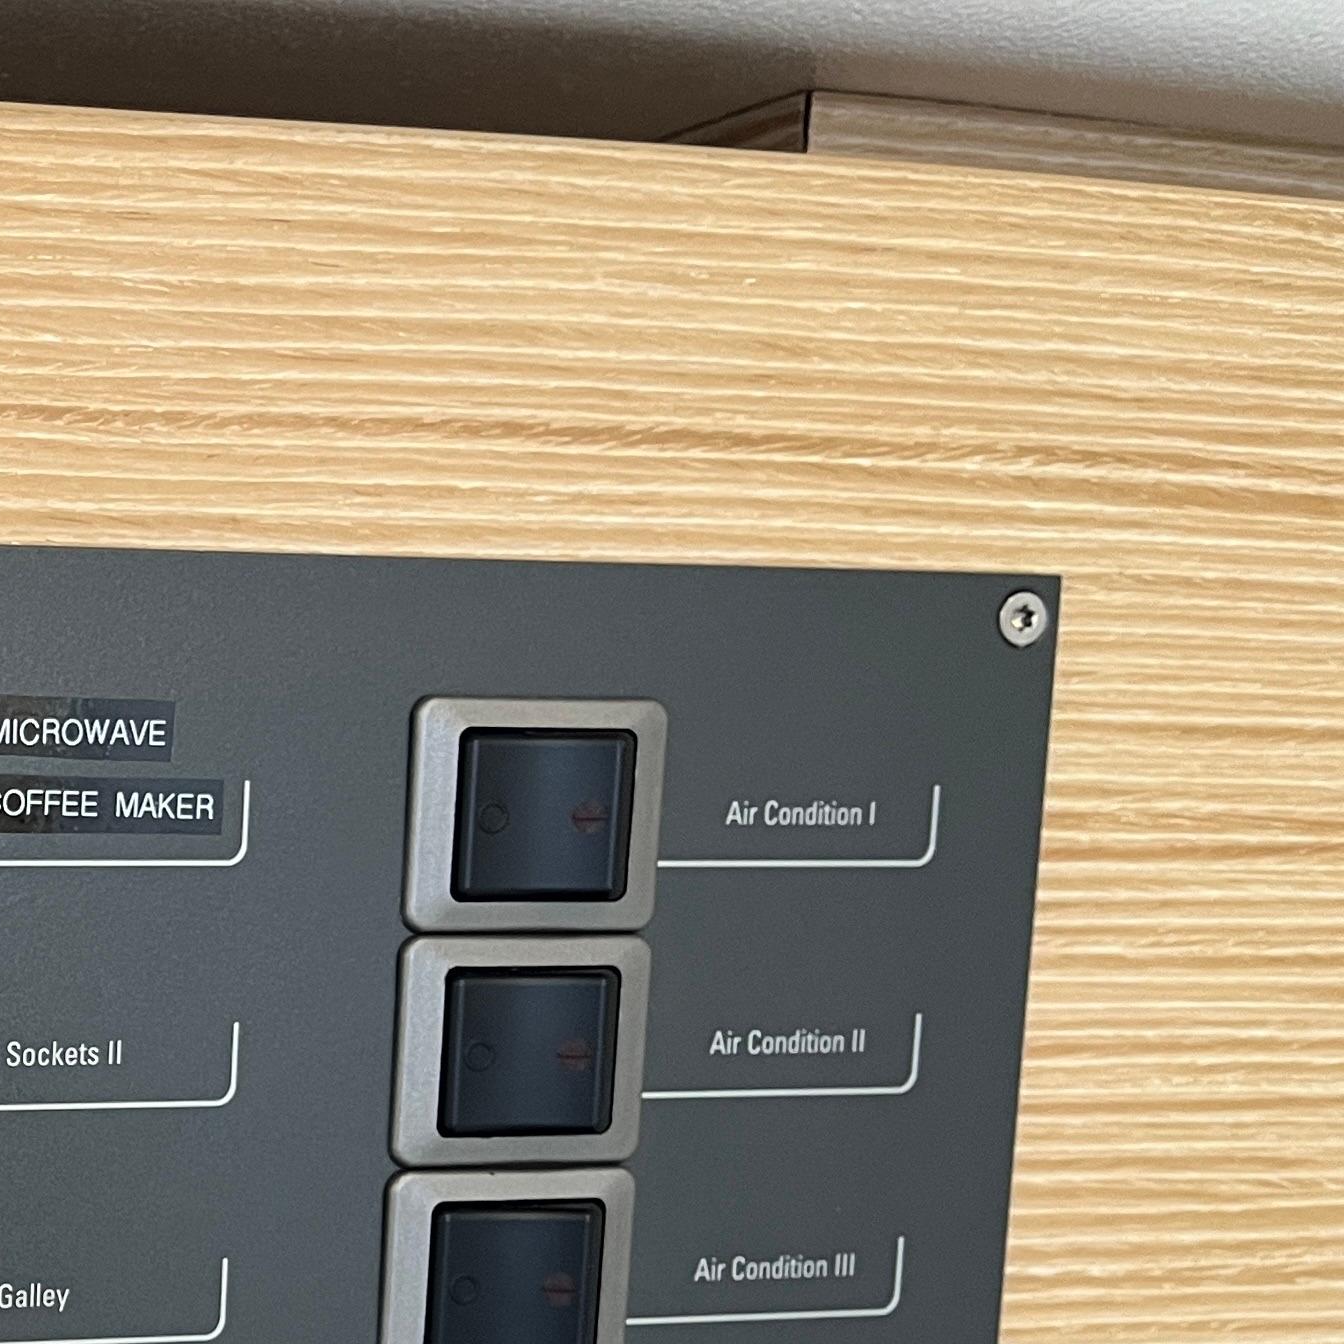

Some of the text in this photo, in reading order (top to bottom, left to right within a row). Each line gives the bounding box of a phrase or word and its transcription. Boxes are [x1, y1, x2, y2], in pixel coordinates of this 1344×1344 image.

[115, 791, 214, 820] MAKER
[725, 799, 876, 826] Air Condition I
[6, 1039, 122, 1068] Sockets II
[709, 1028, 866, 1055] Air Condition II
[694, 1252, 856, 1282] Air Condition III
